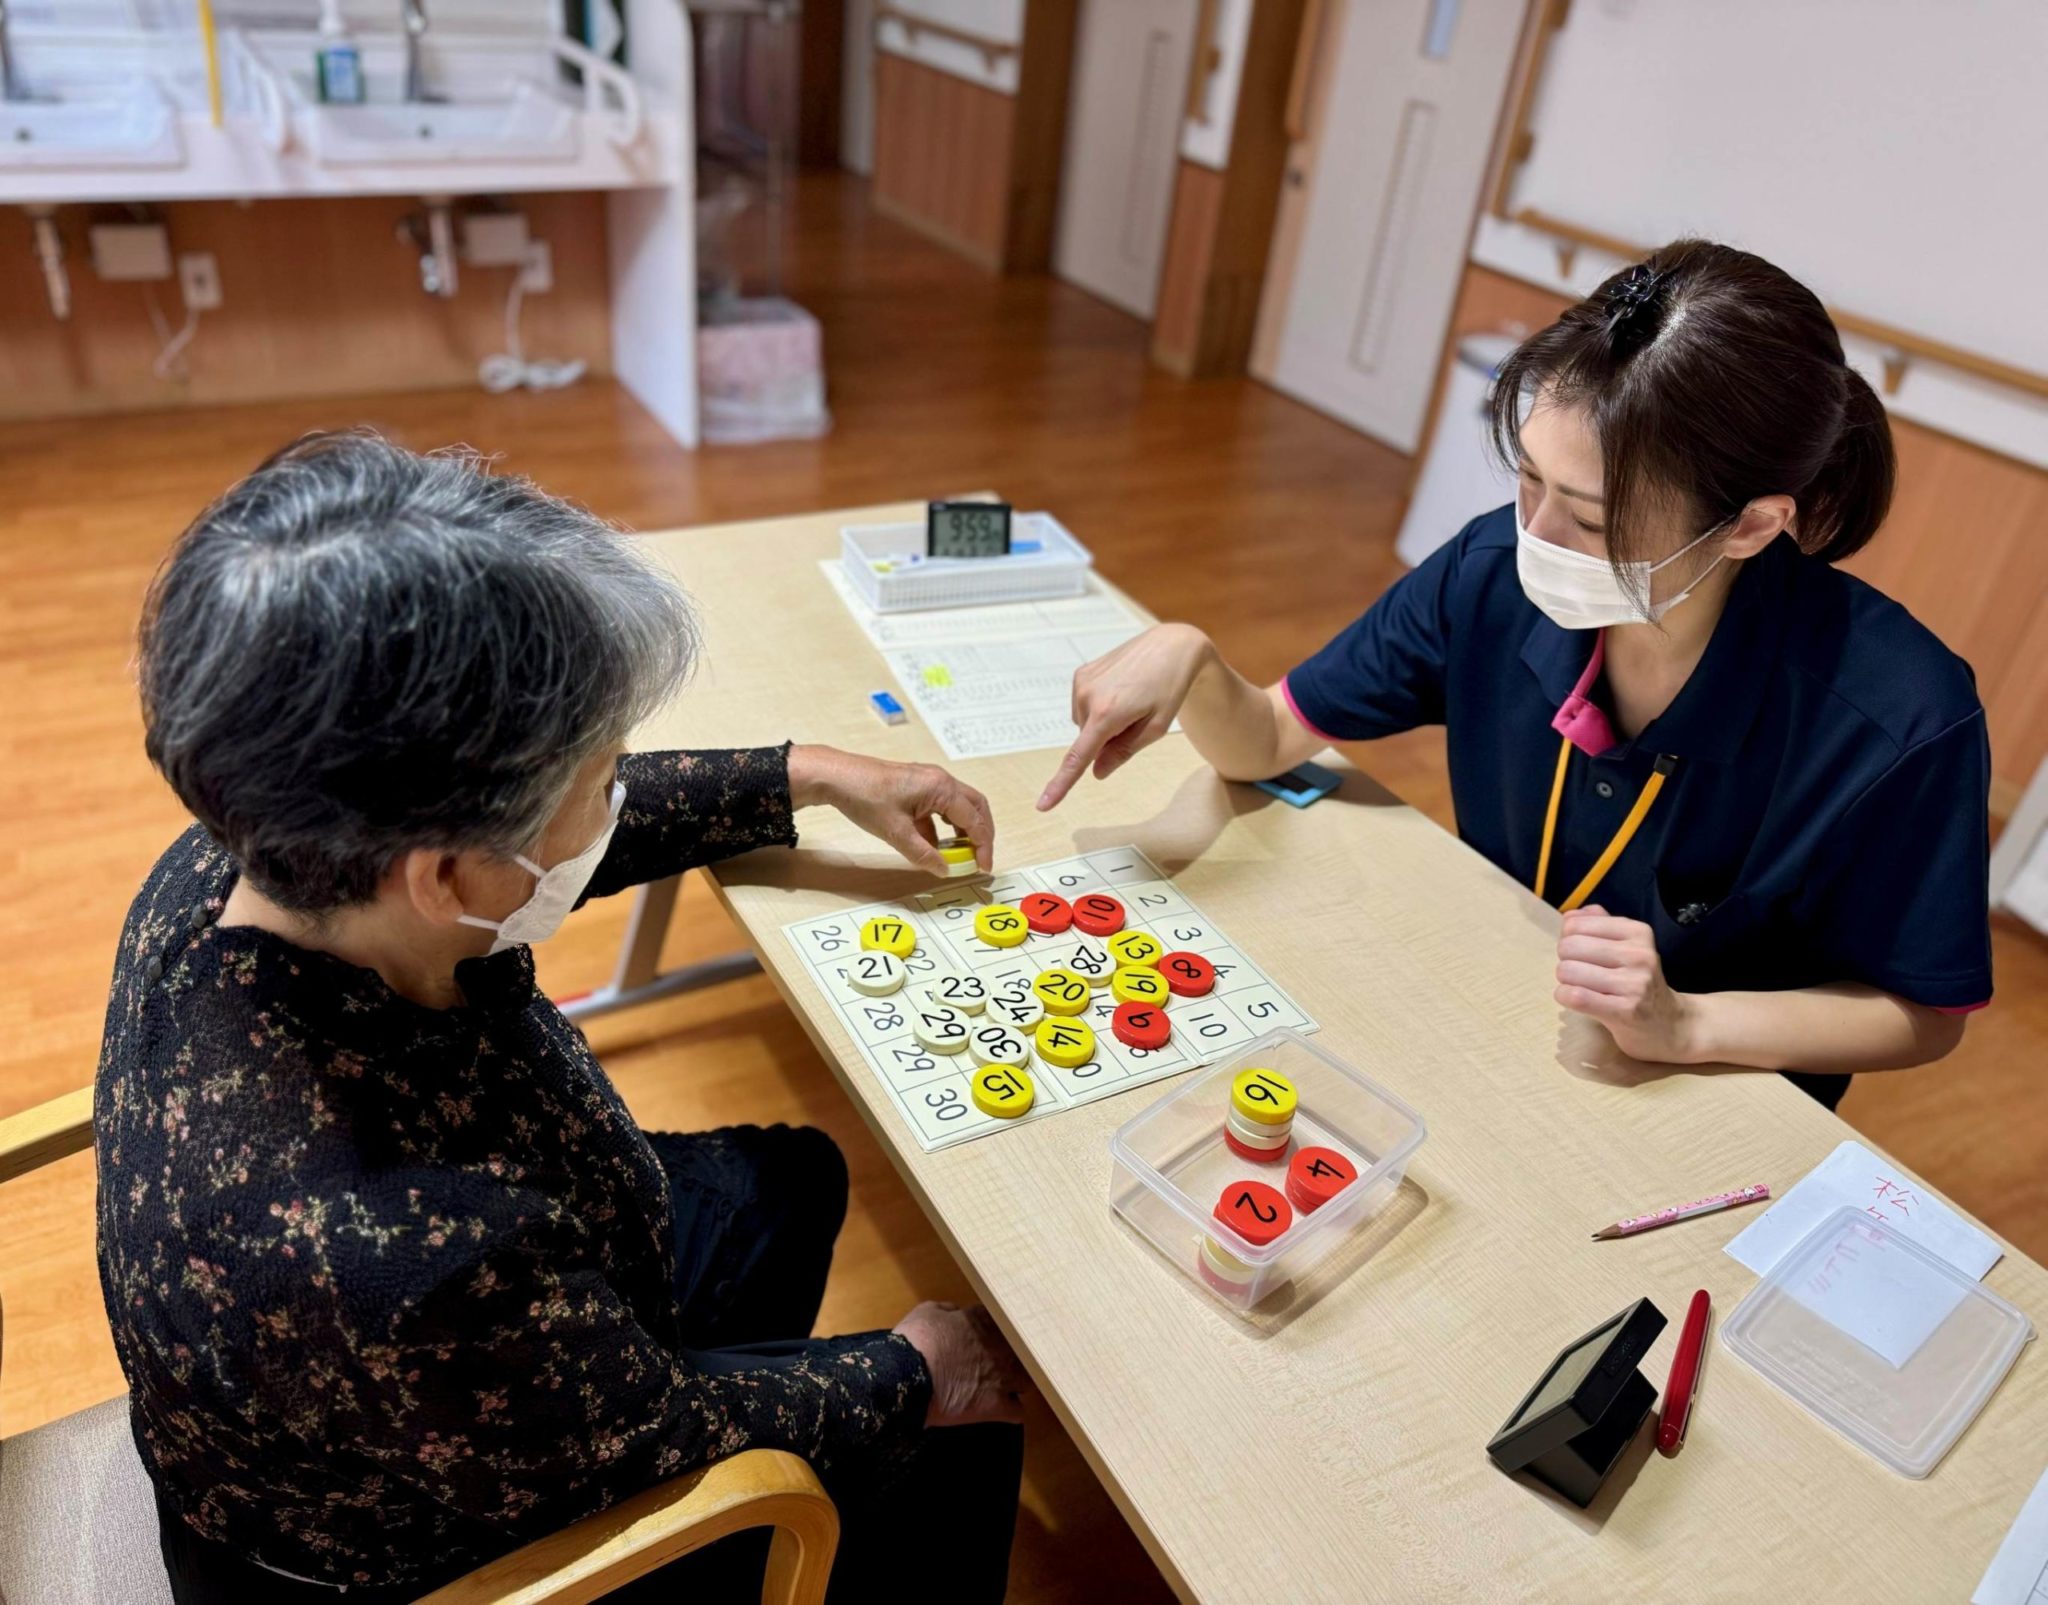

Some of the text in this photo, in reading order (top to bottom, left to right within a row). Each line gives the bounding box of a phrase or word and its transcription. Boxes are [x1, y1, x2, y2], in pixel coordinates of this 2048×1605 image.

[1109, 864, 1134, 873] 1
[1059, 875, 1086, 887] 6
[1039, 899, 1060, 917] 7
[1081, 898, 1117, 921] 10
[1138, 894, 1168, 908] 2
[874, 923, 904, 943] 17
[984, 911, 1020, 931] 18
[811, 925, 850, 951] 26
[1174, 927, 1202, 941] 3
[1070, 945, 1108, 974] 28
[1116, 935, 1154, 960] 13
[858, 956, 893, 979] 21
[1172, 959, 1202, 979] 8
[1213, 965, 1237, 979] 4
[941, 976, 985, 998] 23
[1038, 974, 1085, 1002] 20
[1125, 973, 1158, 994] 19
[863, 1001, 905, 1031] 28
[992, 991, 1038, 1023] 24
[1089, 993, 1117, 1017] 14
[1247, 1001, 1280, 1018] 5
[921, 1009, 966, 1039] 29
[1047, 1024, 1084, 1048] 14
[1188, 1013, 1228, 1038] 10
[977, 1027, 1022, 1058] 30
[892, 1043, 936, 1073] 29
[982, 1070, 1025, 1101] 15
[1244, 1073, 1289, 1106] 16
[925, 1088, 968, 1121] 30
[1306, 1158, 1345, 1180] 4
[1235, 1191, 1278, 1224] 2
